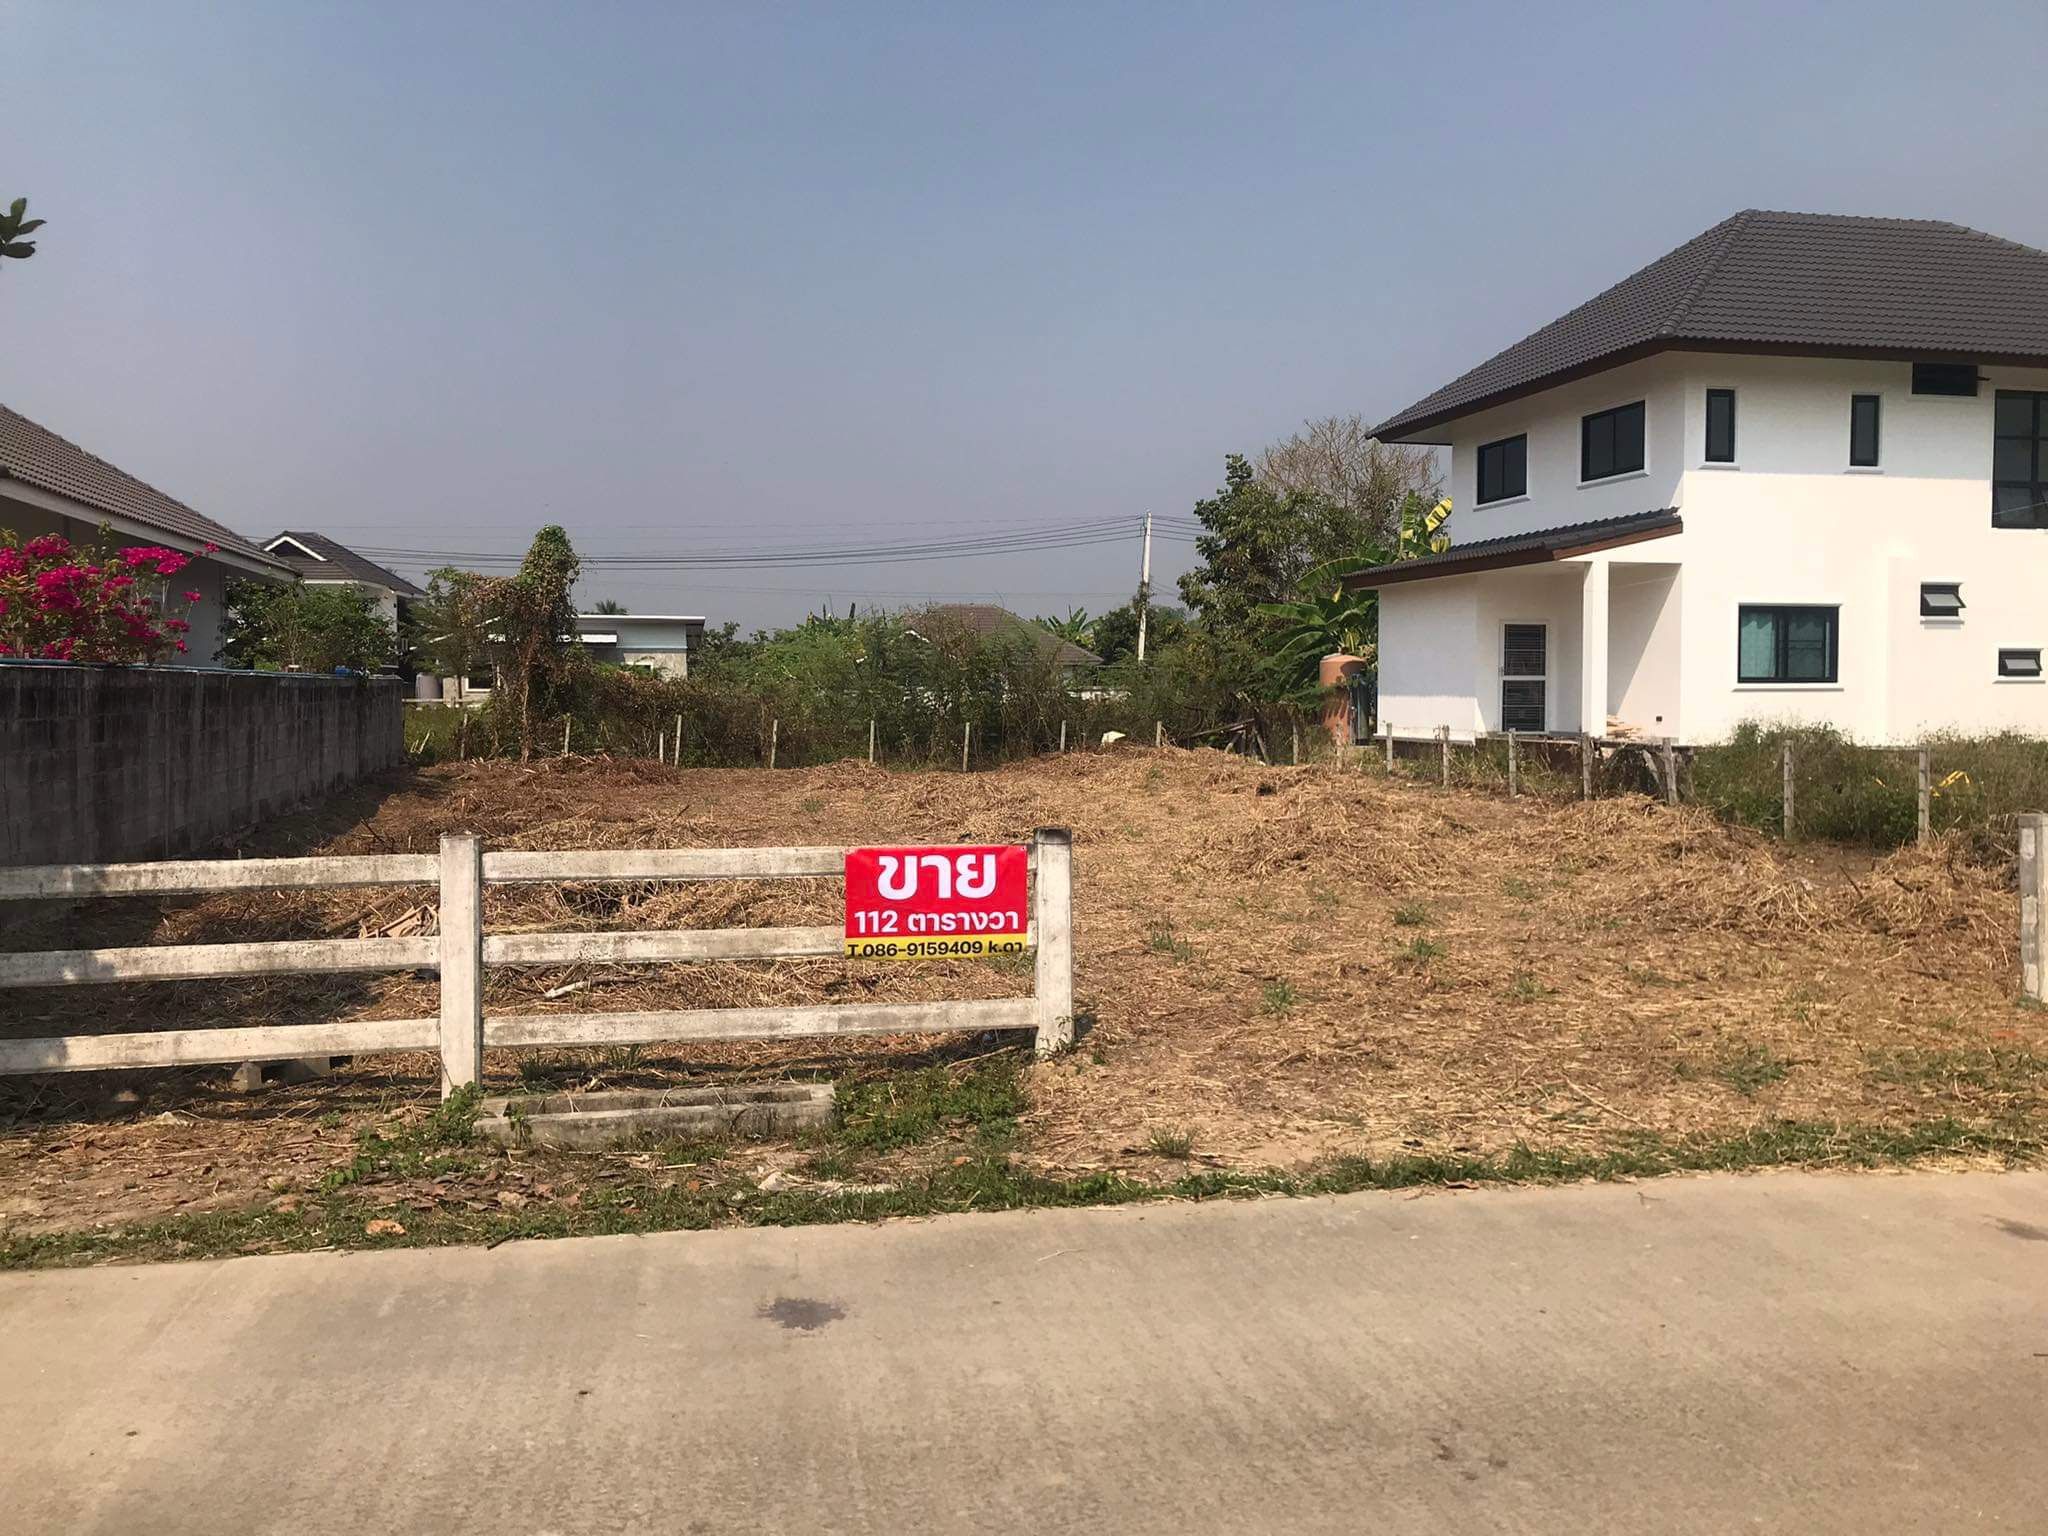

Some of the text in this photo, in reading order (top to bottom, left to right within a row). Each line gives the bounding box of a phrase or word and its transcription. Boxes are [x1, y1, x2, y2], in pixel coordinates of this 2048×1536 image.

[877, 854, 997, 901] ขาย
[854, 910, 1019, 934] 112 ตารางวา
[847, 941, 983, 957] T.086-9159409
